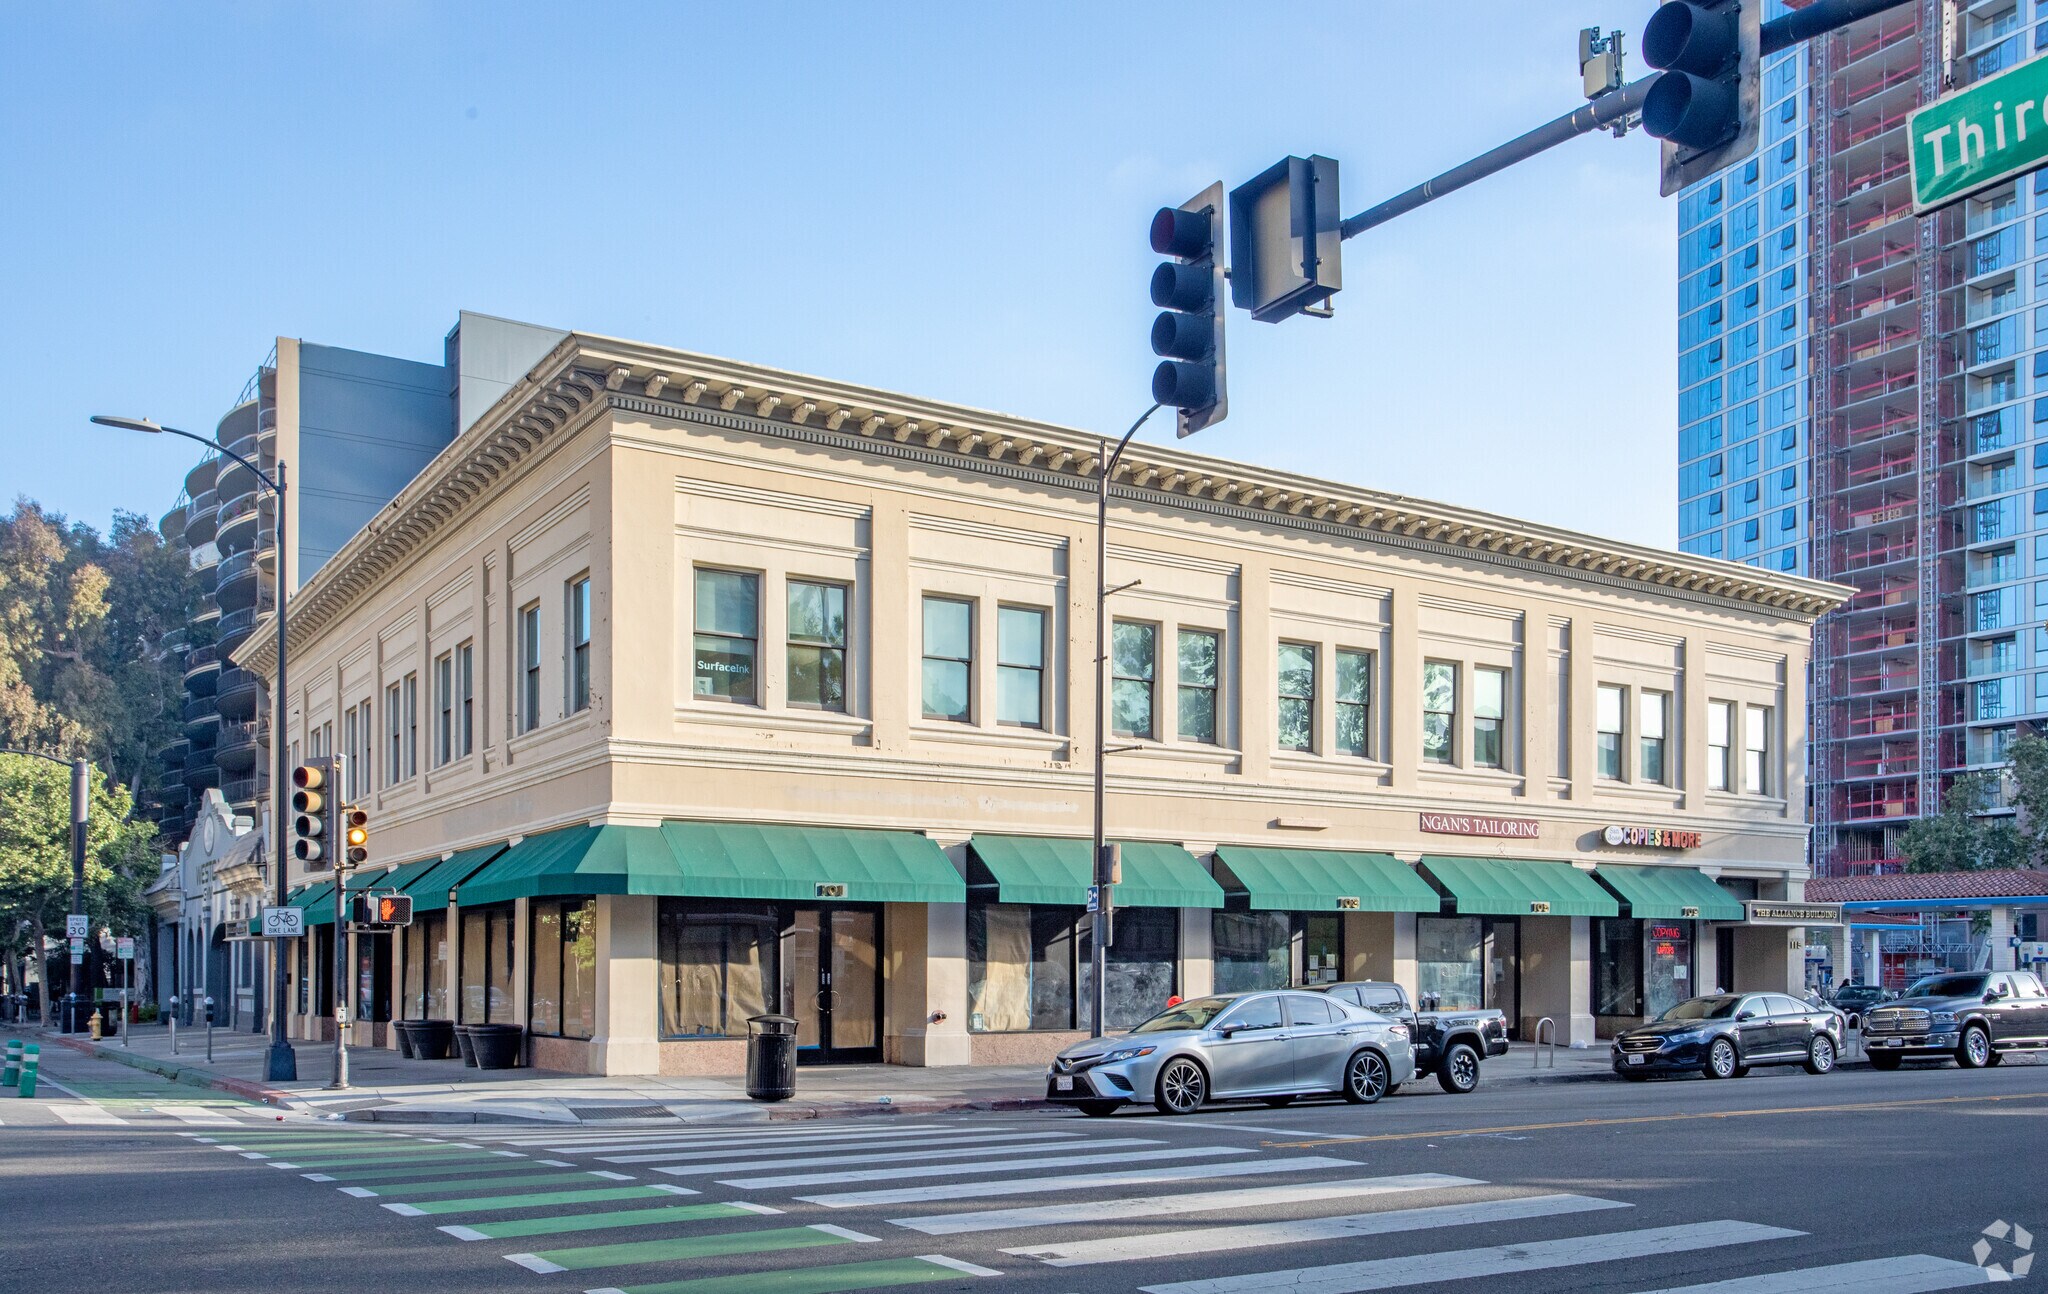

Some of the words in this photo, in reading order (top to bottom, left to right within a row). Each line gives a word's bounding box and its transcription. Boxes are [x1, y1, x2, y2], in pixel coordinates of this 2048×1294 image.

[1923, 96, 2048, 177] Thir
[1421, 815, 1470, 832] NGAN'S
[1473, 819, 1539, 837] TAILORING
[1623, 826, 1662, 847] COPIES
[1663, 829, 1671, 847] &
[1672, 831, 1702, 849] MORE
[816, 885, 844, 898] 101
[1756, 908, 1771, 917] THE
[1772, 909, 1805, 919] ALLIANCE
[1805, 910, 1838, 919] BUILDING
[69, 926, 86, 935] 30
